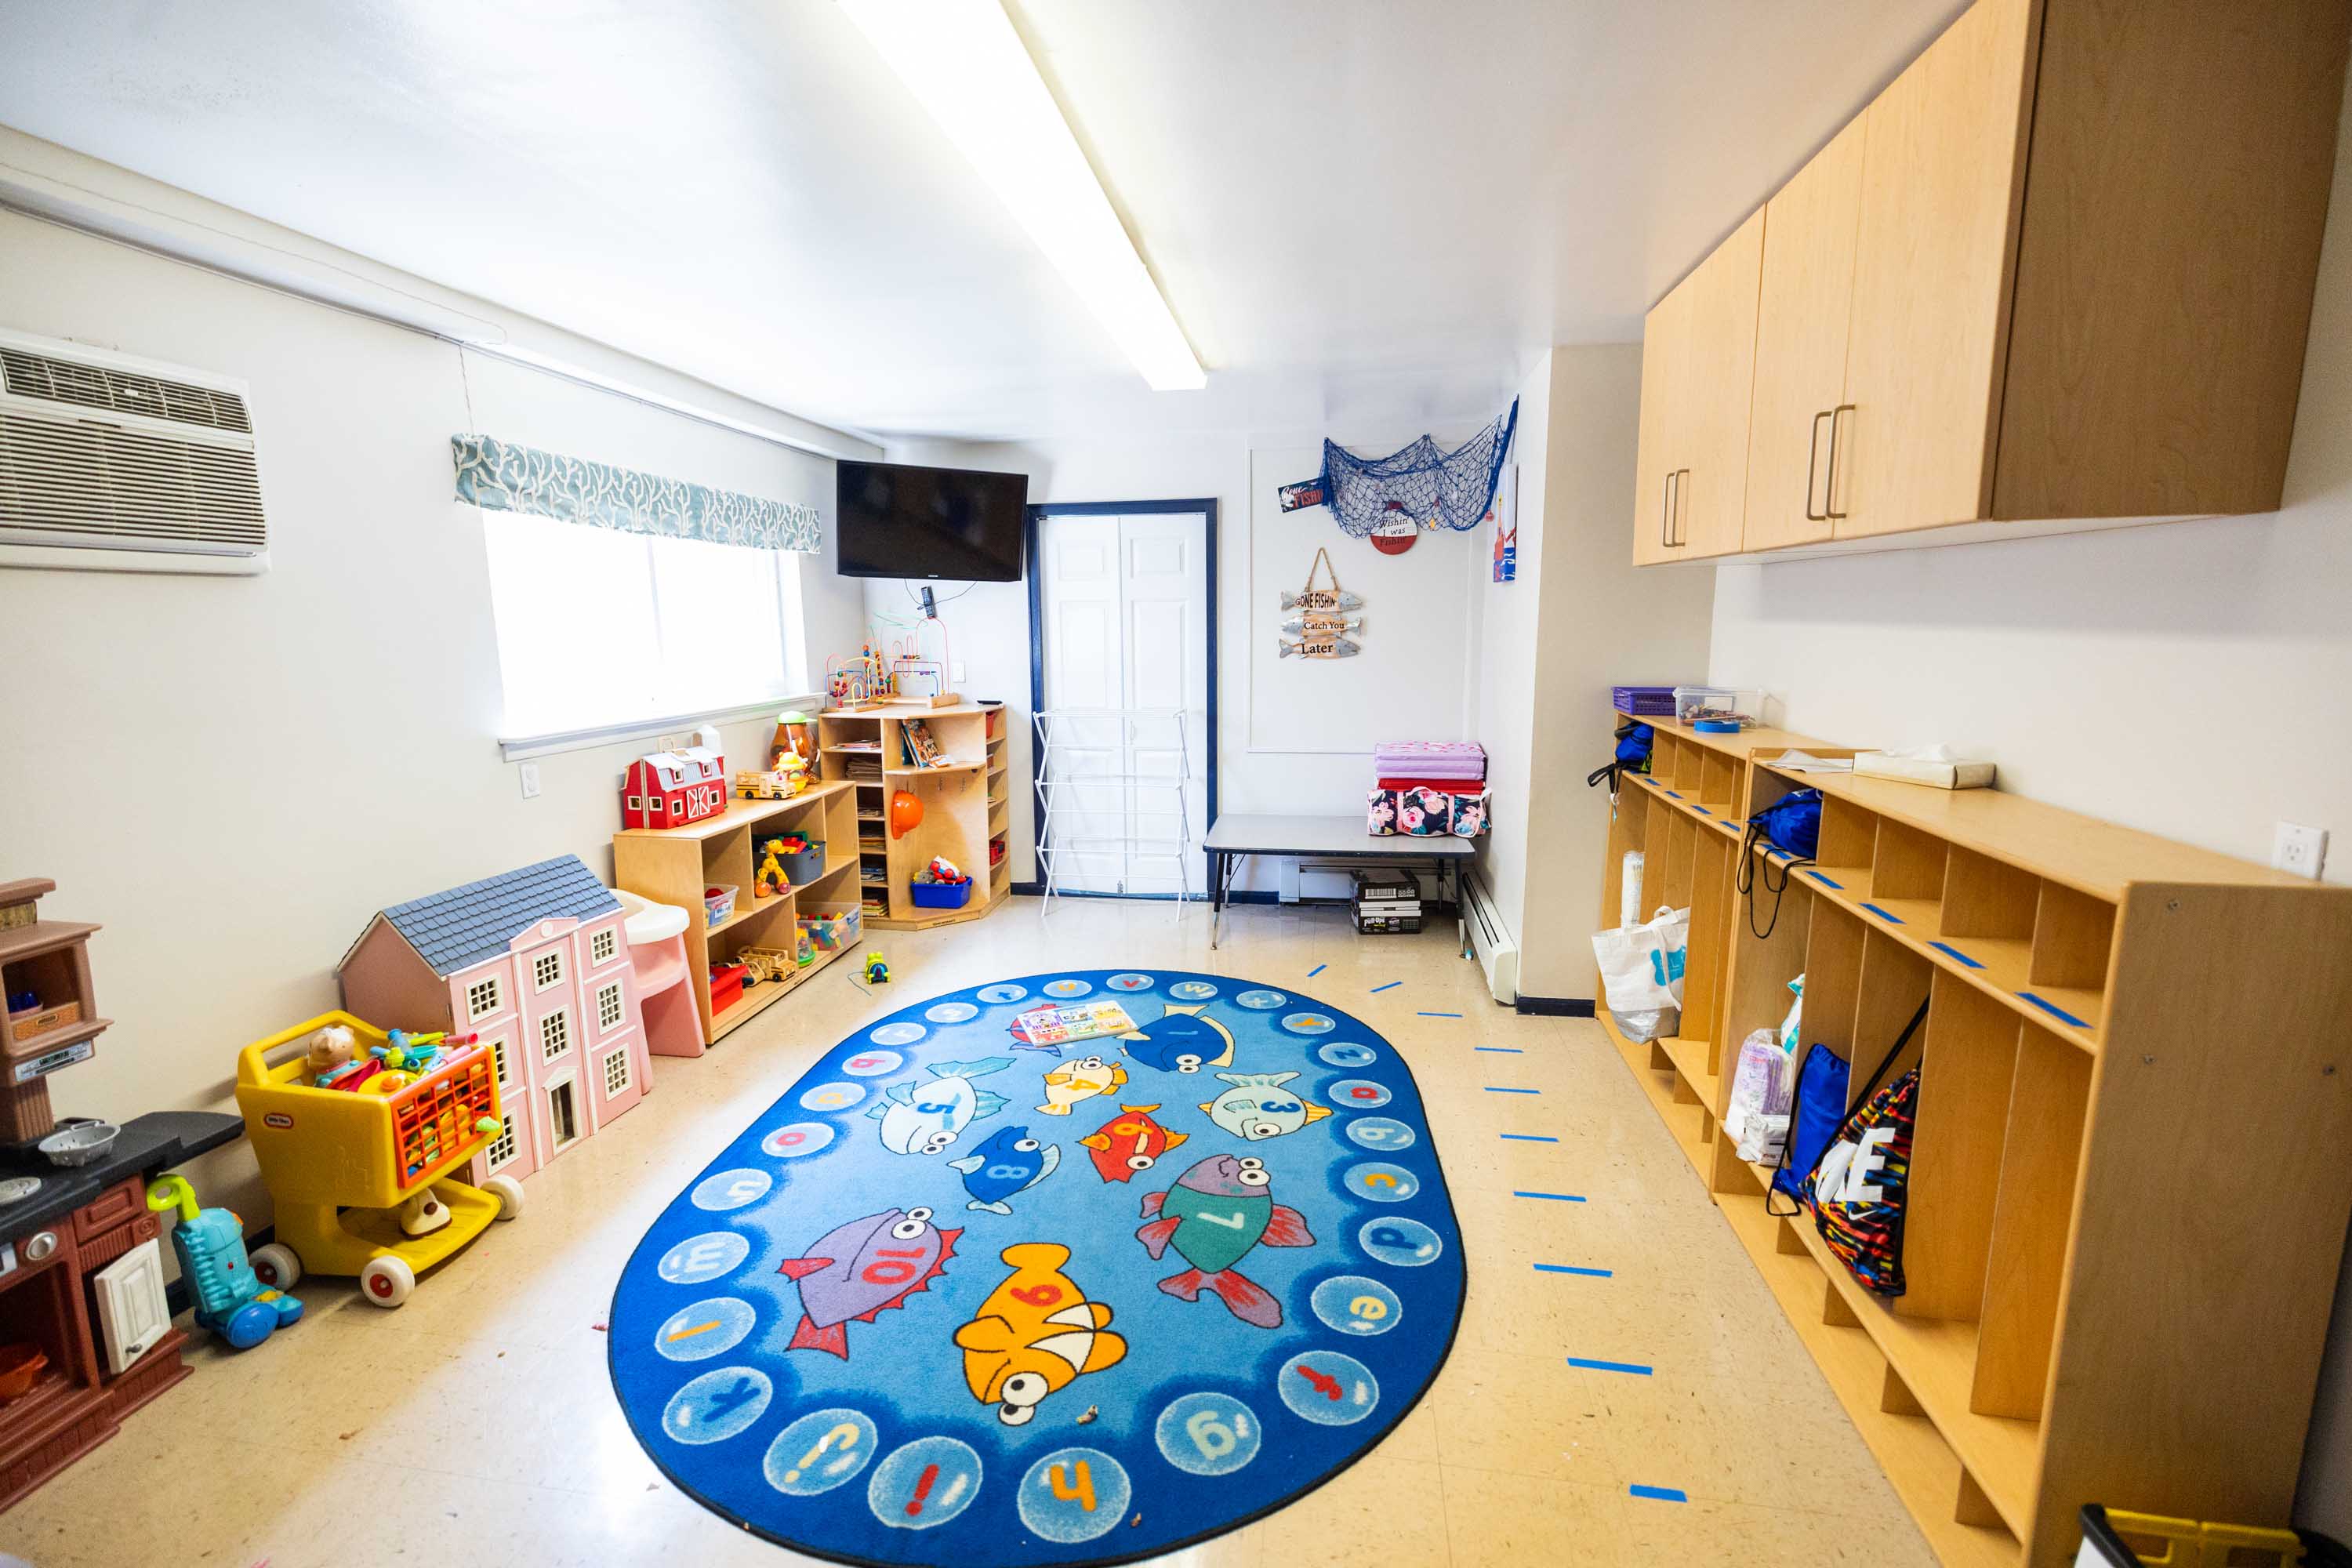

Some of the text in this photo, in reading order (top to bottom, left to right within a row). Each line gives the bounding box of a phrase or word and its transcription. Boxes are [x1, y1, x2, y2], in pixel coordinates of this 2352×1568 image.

[1295, 593, 1313, 608] GONE
[1301, 643, 1334, 654] Later
[1066, 1079, 1100, 1091] 4
[917, 1103, 952, 1116] 5
[1261, 1102, 1298, 1114] 3
[987, 1164, 1029, 1179] 8
[1196, 1210, 1245, 1229] 7
[862, 1247, 927, 1285] 10
[1349, 1296, 1387, 1320] e
